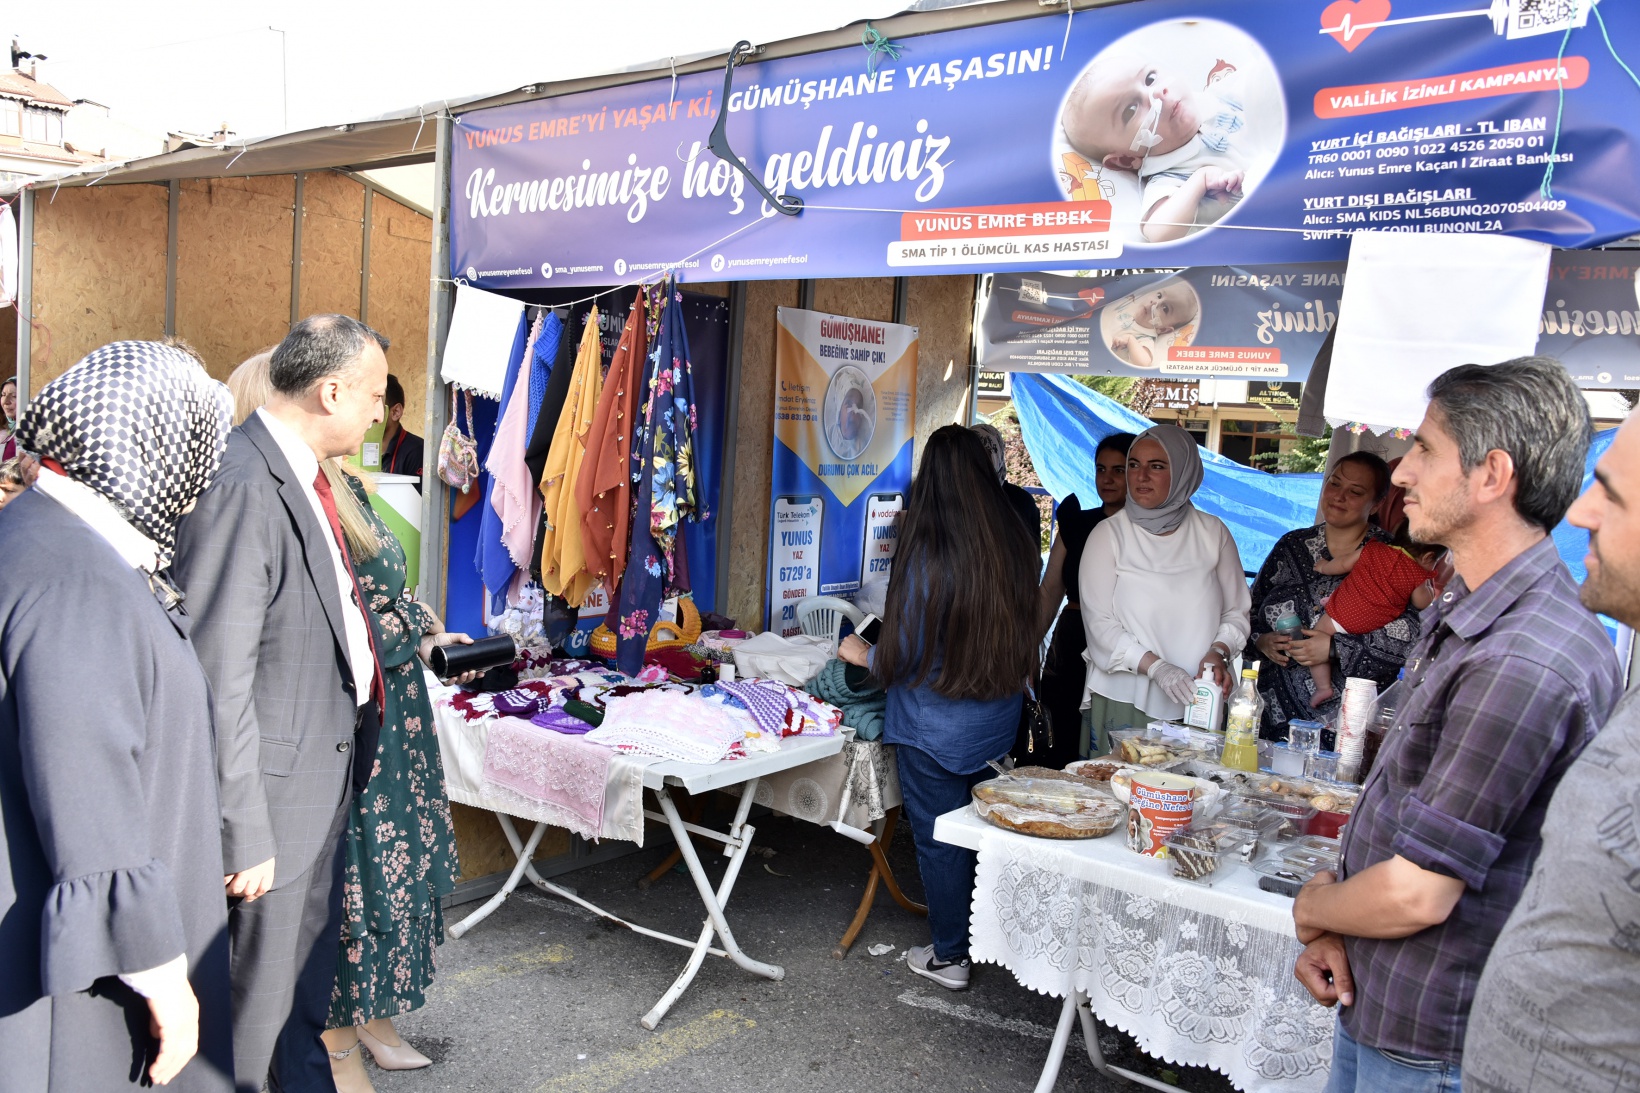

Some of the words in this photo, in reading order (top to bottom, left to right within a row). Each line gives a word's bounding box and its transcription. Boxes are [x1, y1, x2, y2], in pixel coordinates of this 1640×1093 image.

[465, 125, 523, 150] YUNUS
[528, 107, 607, 141] EMRE'Yİ
[613, 98, 682, 132] YAŞAT
[687, 90, 716, 120] Kİ,
[727, 69, 896, 110] GÜMÜŞHANE
[906, 45, 1054, 91] YAŞASIN!
[1330, 90, 1398, 109] VALİLİK
[1402, 80, 1456, 98] İZİNLİ
[1460, 66, 1569, 92] KAMPANYA
[1310, 136, 1350, 151] YURT
[1352, 131, 1373, 148] İÇİ
[1376, 124, 1461, 144] BAĞIŞLARI
[1477, 120, 1496, 134] TL
[1504, 117, 1546, 132] IBAN
[1308, 152, 1338, 165] TR60
[1341, 150, 1371, 162] 0001
[1376, 146, 1408, 158] 0090
[1414, 143, 1446, 155] 1022
[1450, 140, 1485, 154] 4526
[1489, 138, 1524, 150] 2050
[1528, 136, 1544, 147] 01
[466, 153, 672, 224] Kermesimize
[682, 141, 748, 214] hoş
[761, 118, 956, 216] geldiniz
[1305, 168, 1334, 180] Alıcı:
[1338, 166, 1374, 178] Yunus
[1378, 164, 1412, 175] Emre
[1416, 160, 1458, 173] Kaçan
[1469, 155, 1514, 168] Ziraat
[1518, 152, 1574, 166] Bankası
[1304, 196, 1344, 210] YURT
[1348, 194, 1380, 208] DIŞI
[1386, 188, 1472, 206] BAĞIŞLARI
[914, 217, 972, 232] YUNUS
[978, 214, 1026, 230] EMRE
[1032, 210, 1093, 226] BEBEK
[1303, 214, 1332, 225] Alıcı:
[1336, 212, 1366, 223] SMA
[1370, 210, 1402, 221] KIDS
[1405, 200, 1566, 219] NL56BUNQ2070504409
[1303, 228, 1343, 240] SWIFT
[1424, 220, 1502, 234] BUNQNL2A
[901, 248, 926, 259] SMA
[930, 244, 948, 257] TİP
[952, 247, 957, 257] 1
[961, 242, 1020, 256] ÖLÜMCÜL
[1024, 243, 1050, 254] KAS
[1054, 240, 1109, 252] HASTASI
[555, 264, 603, 274] sma_yunusemre
[728, 254, 808, 268] yunusemreyenefesol
[820, 316, 885, 345] GÜMÜŞHANE!
[820, 344, 849, 360] BEBEĞİNE
[850, 349, 870, 363] SAHİP
[872, 351, 885, 365] ÇIK!
[818, 464, 845, 476] DURUMU
[847, 464, 859, 478] ÇOK
[861, 462, 878, 476] ACİL!
[781, 530, 812, 546] YUNUS
[873, 525, 897, 540] YUNUS
[792, 551, 803, 560] YAZ
[880, 544, 889, 552] YAZ
[780, 566, 812, 582] 6729'a
[783, 588, 807, 600] GÖNDER!
[782, 605, 794, 620] 20
